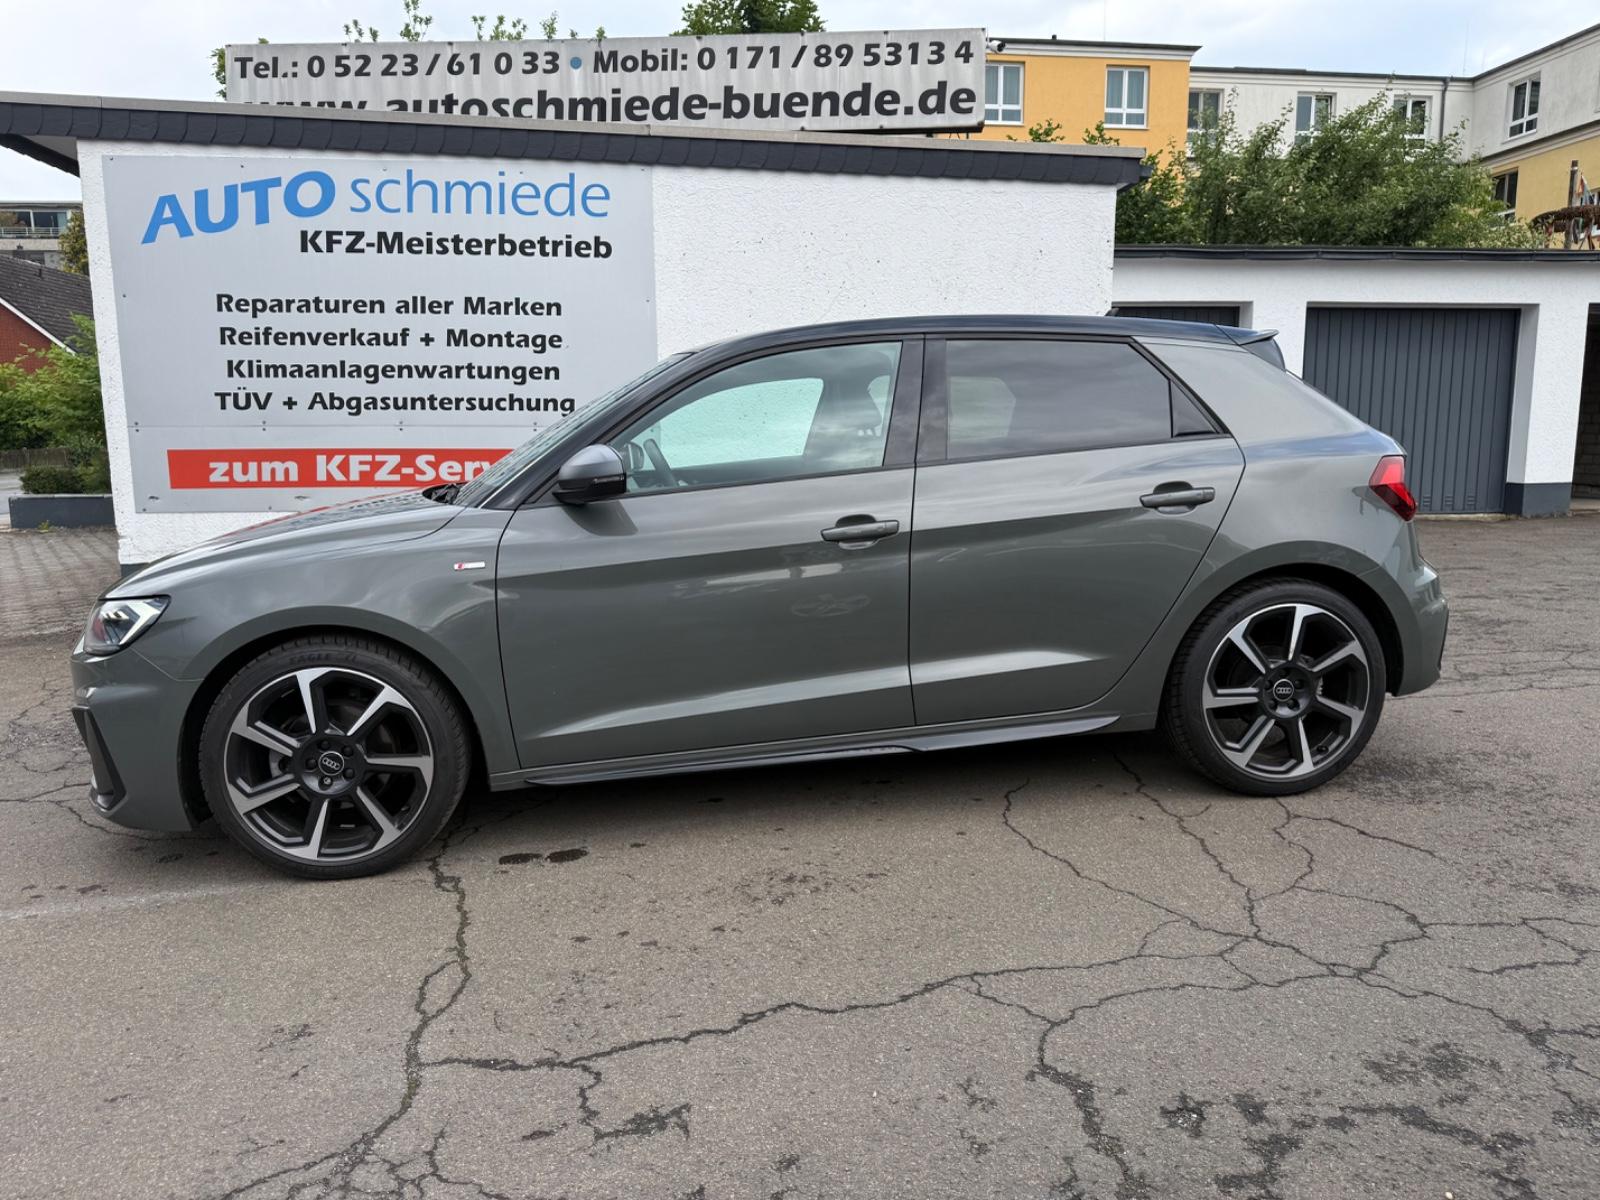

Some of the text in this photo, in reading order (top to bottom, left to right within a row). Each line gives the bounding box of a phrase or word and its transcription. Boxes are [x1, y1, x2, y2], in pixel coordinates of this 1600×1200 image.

[233, 56, 298, 79] Tel.:
[593, 48, 688, 74] Mobil:
[244, 81, 977, 123] toschmiede-buende.de
[300, 230, 613, 259] KFZ-Meisterbetrieb
[216, 293, 562, 319] Reparaturen aller Marken
[219, 326, 563, 354] Reifenverkauf + Montage
[227, 359, 560, 386] Klimaanlagenwartungen
[214, 387, 576, 418] TÜV + Abgasuntersuchung
[209, 460, 299, 483] zum
